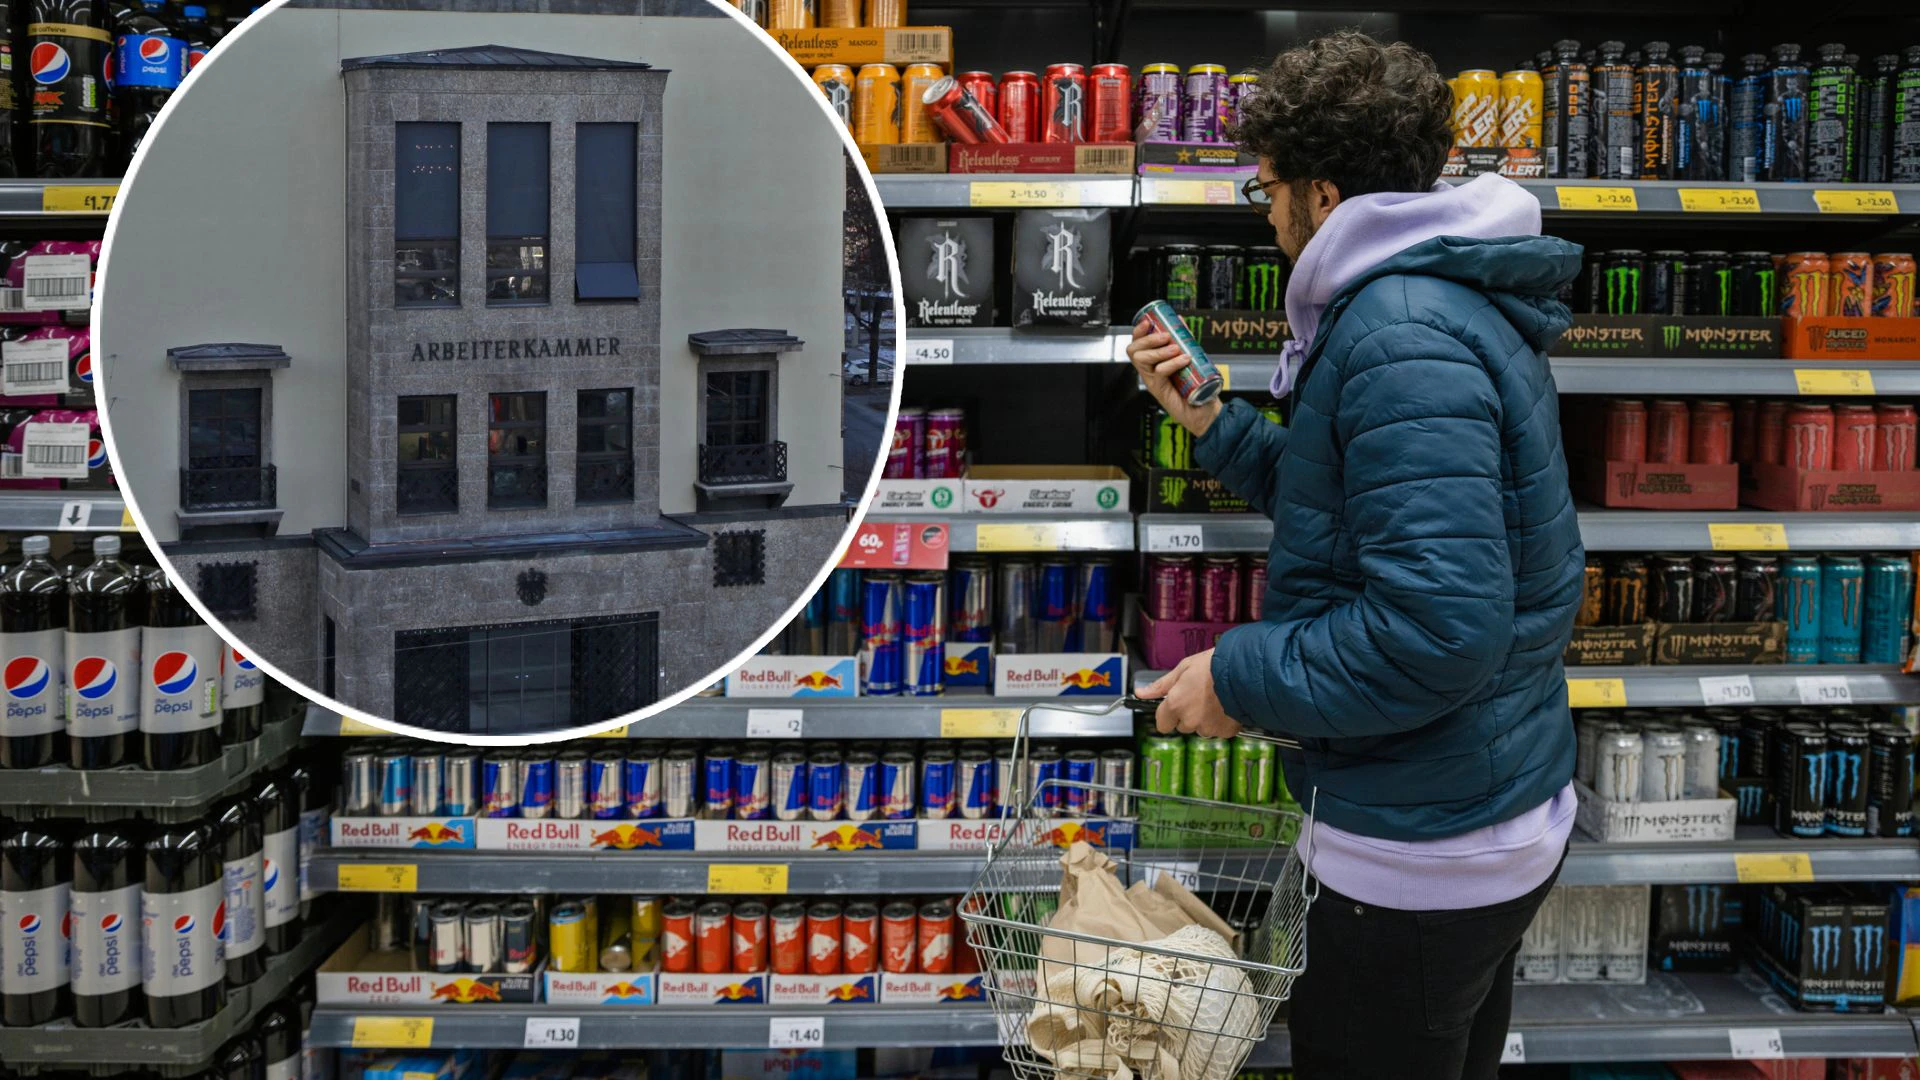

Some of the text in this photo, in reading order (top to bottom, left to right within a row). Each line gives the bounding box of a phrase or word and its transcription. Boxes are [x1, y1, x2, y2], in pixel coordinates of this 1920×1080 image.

[778, 33, 878, 50] Relentless MANGO
[142, 66, 167, 75] pepsi
[1643, 79, 1660, 168] MONSTER
[1441, 164, 1468, 176] ERT
[1496, 164, 1545, 177] ALERT
[85, 195, 116, 211] £1.7
[1048, 220, 1084, 290] R
[933, 231, 971, 299] R
[1031, 288, 1093, 316] Relentless
[917, 297, 978, 325] Relentless
[1211, 317, 1289, 340] MONST
[1685, 326, 1773, 343] MONSTER
[1825, 328, 1868, 339] JUICED
[411, 336, 621, 363] ARBEITERKAMMER
[1230, 341, 1279, 349] ENER
[916, 347, 950, 361] £4.50
[859, 533, 884, 548] 60p
[1170, 535, 1200, 548] £1.70
[1570, 639, 1638, 651] MONSTER
[1689, 633, 1761, 647] MONSTER
[740, 670, 791, 683] Red Bull
[1007, 669, 1058, 682] Red Bull
[1722, 685, 1751, 698] £1.70
[1818, 687, 1848, 699] £1.70
[7, 704, 46, 719] pepsi
[76, 704, 114, 719] pepsi
[154, 700, 193, 714] pepsi
[788, 720, 800, 732] £2
[1644, 813, 1722, 827] MONSTER
[341, 823, 400, 837] Red Bull
[507, 823, 580, 839] Red Bull
[727, 824, 800, 841] Red Bull
[951, 823, 986, 840] Red
[507, 842, 546, 850] ENERGY
[1669, 941, 1731, 953] MONSTER
[25, 935, 39, 976] pepsi
[106, 935, 121, 976] pepsi
[179, 936, 194, 977] pepsi
[348, 976, 421, 993] Red Bull
[552, 979, 597, 991] Red Bull
[663, 982, 708, 993] Red Bull
[774, 983, 820, 994] Red Bull
[886, 982, 931, 993] Red Bull
[546, 1028, 575, 1042] £1.30
[789, 1029, 820, 1042] £1.40
